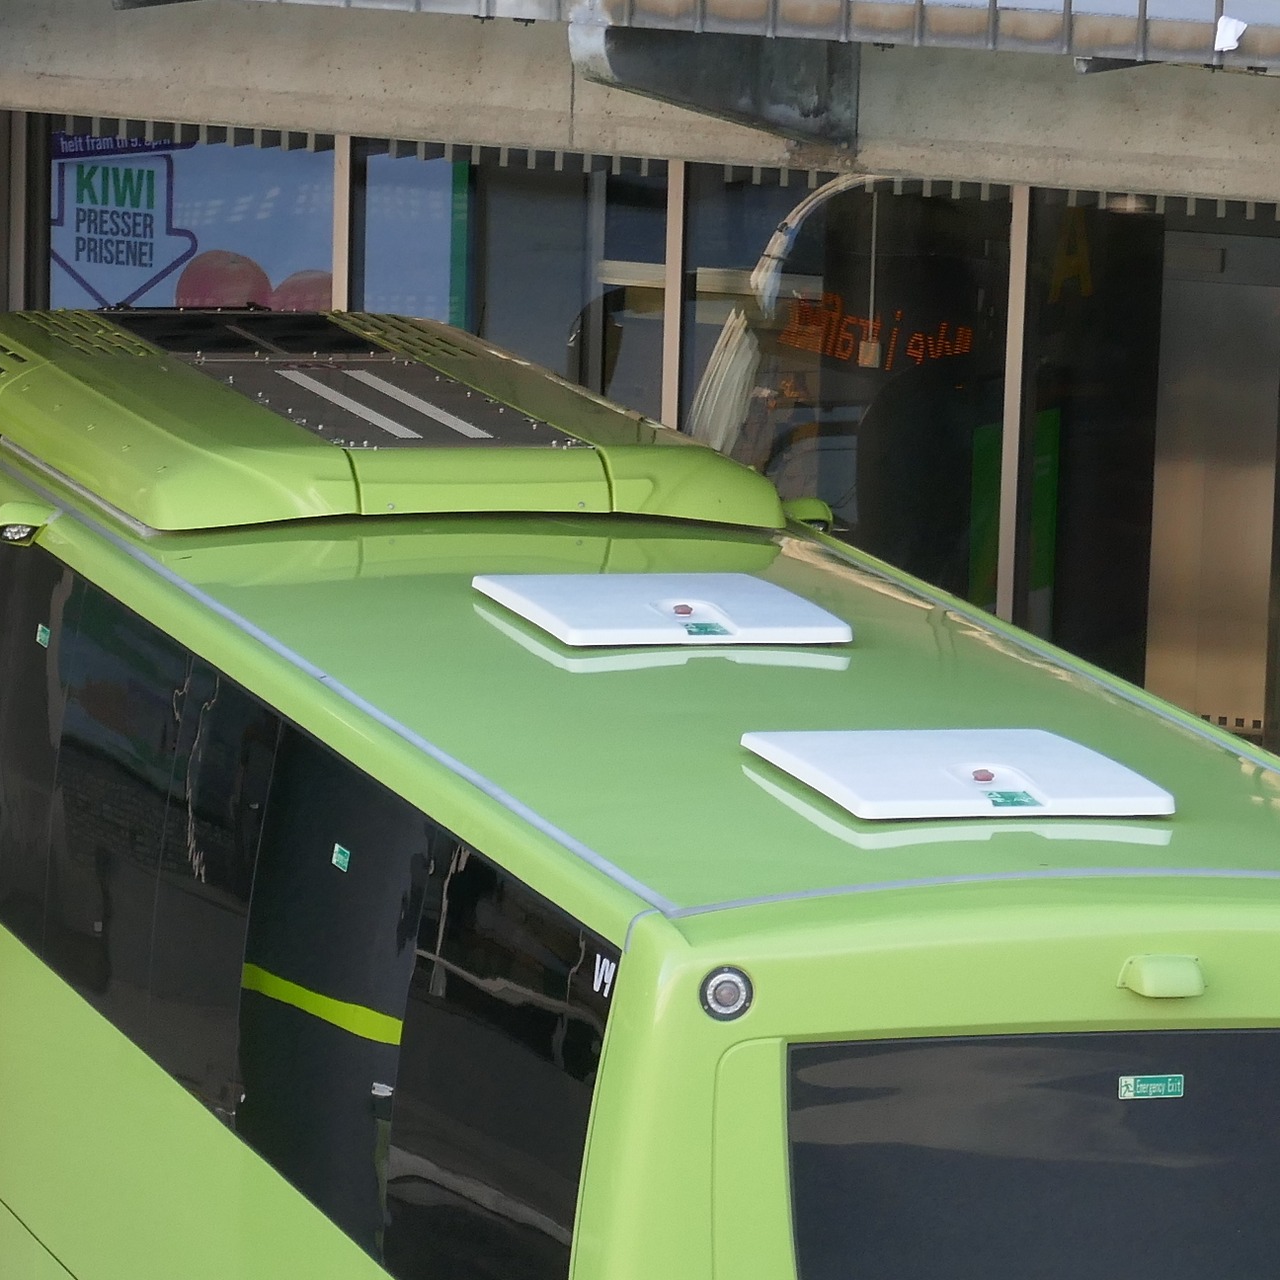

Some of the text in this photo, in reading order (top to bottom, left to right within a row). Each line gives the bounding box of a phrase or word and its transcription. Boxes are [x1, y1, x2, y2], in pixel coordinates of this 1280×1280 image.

[76, 164, 154, 210] KIWI
[76, 207, 154, 239] PRESSER
[75, 236, 154, 268] PRISENE!
[1167, 1077, 1181, 1093] Exit
